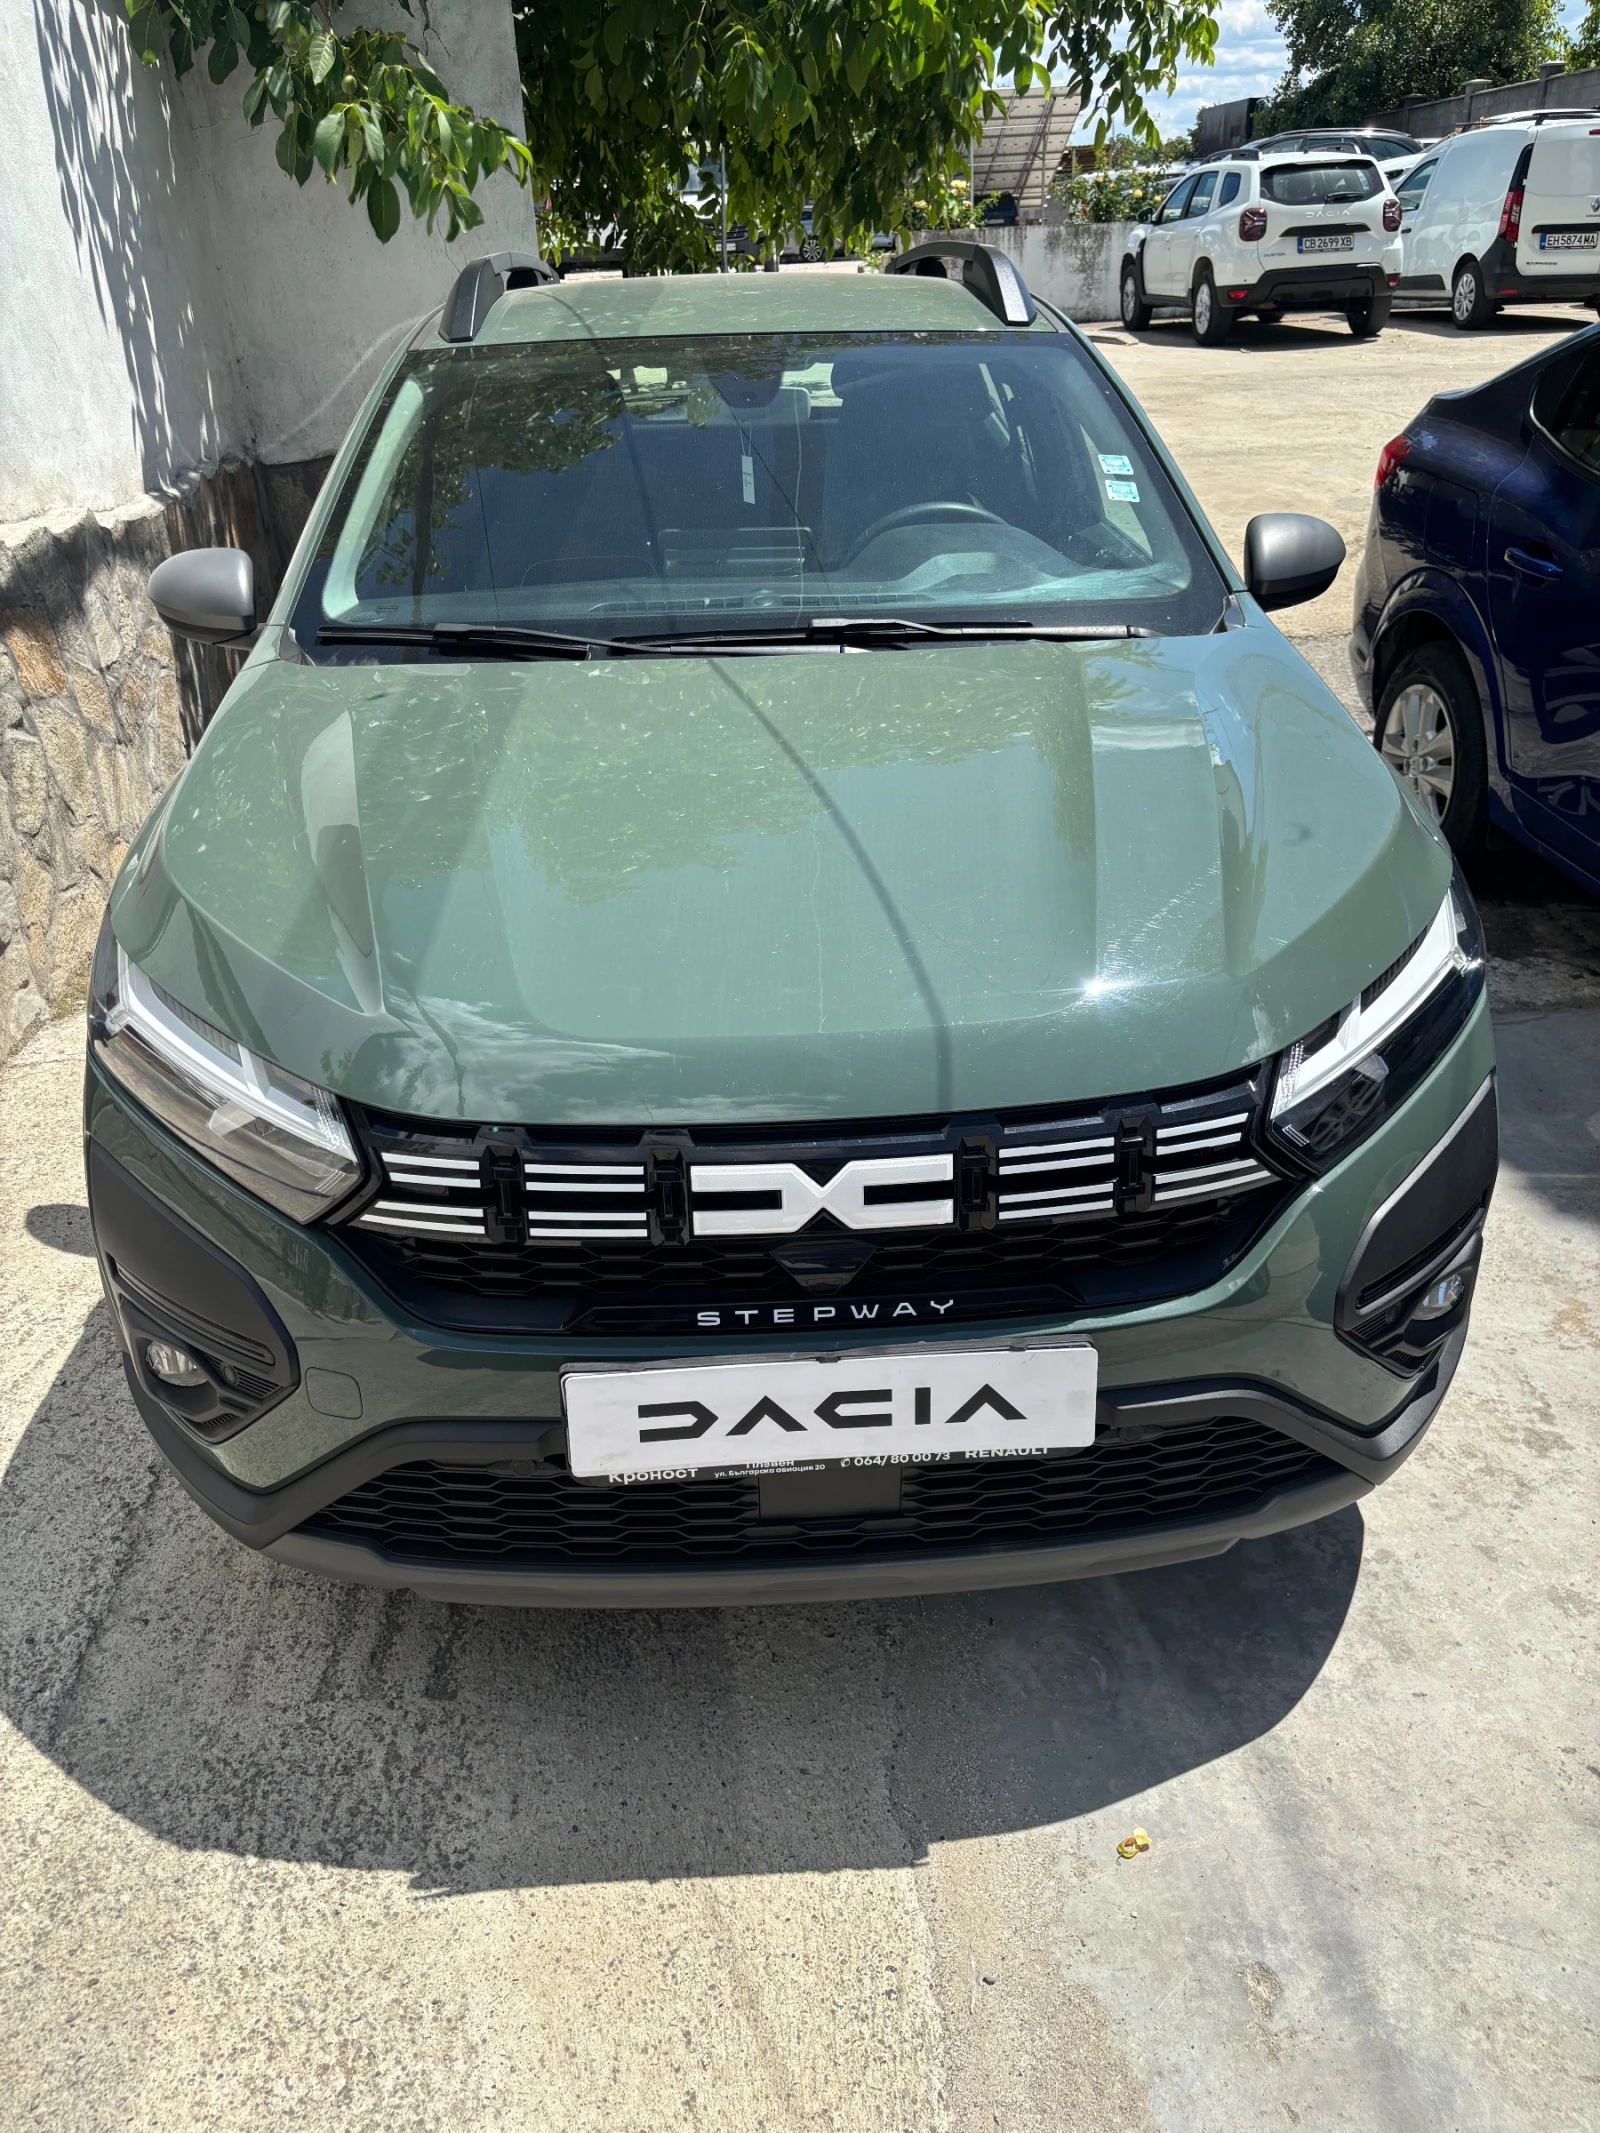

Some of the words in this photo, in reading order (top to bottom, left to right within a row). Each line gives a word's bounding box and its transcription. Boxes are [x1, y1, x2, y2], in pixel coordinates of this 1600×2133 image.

[1305, 209, 1351, 219] DACIA
[1304, 238, 1316, 249] CB
[1317, 237, 1339, 249] 2699
[1340, 236, 1352, 247] XB
[1560, 234, 1583, 246] 5874
[697, 1299, 955, 1327] STEPWAY
[637, 1383, 1029, 1443] DACIA
[890, 1454, 909, 1464] 80
[912, 1453, 931, 1463] 00
[934, 1451, 951, 1462] 73
[814, 1463, 826, 1471] 20
[608, 1467, 699, 1485] Кроност
